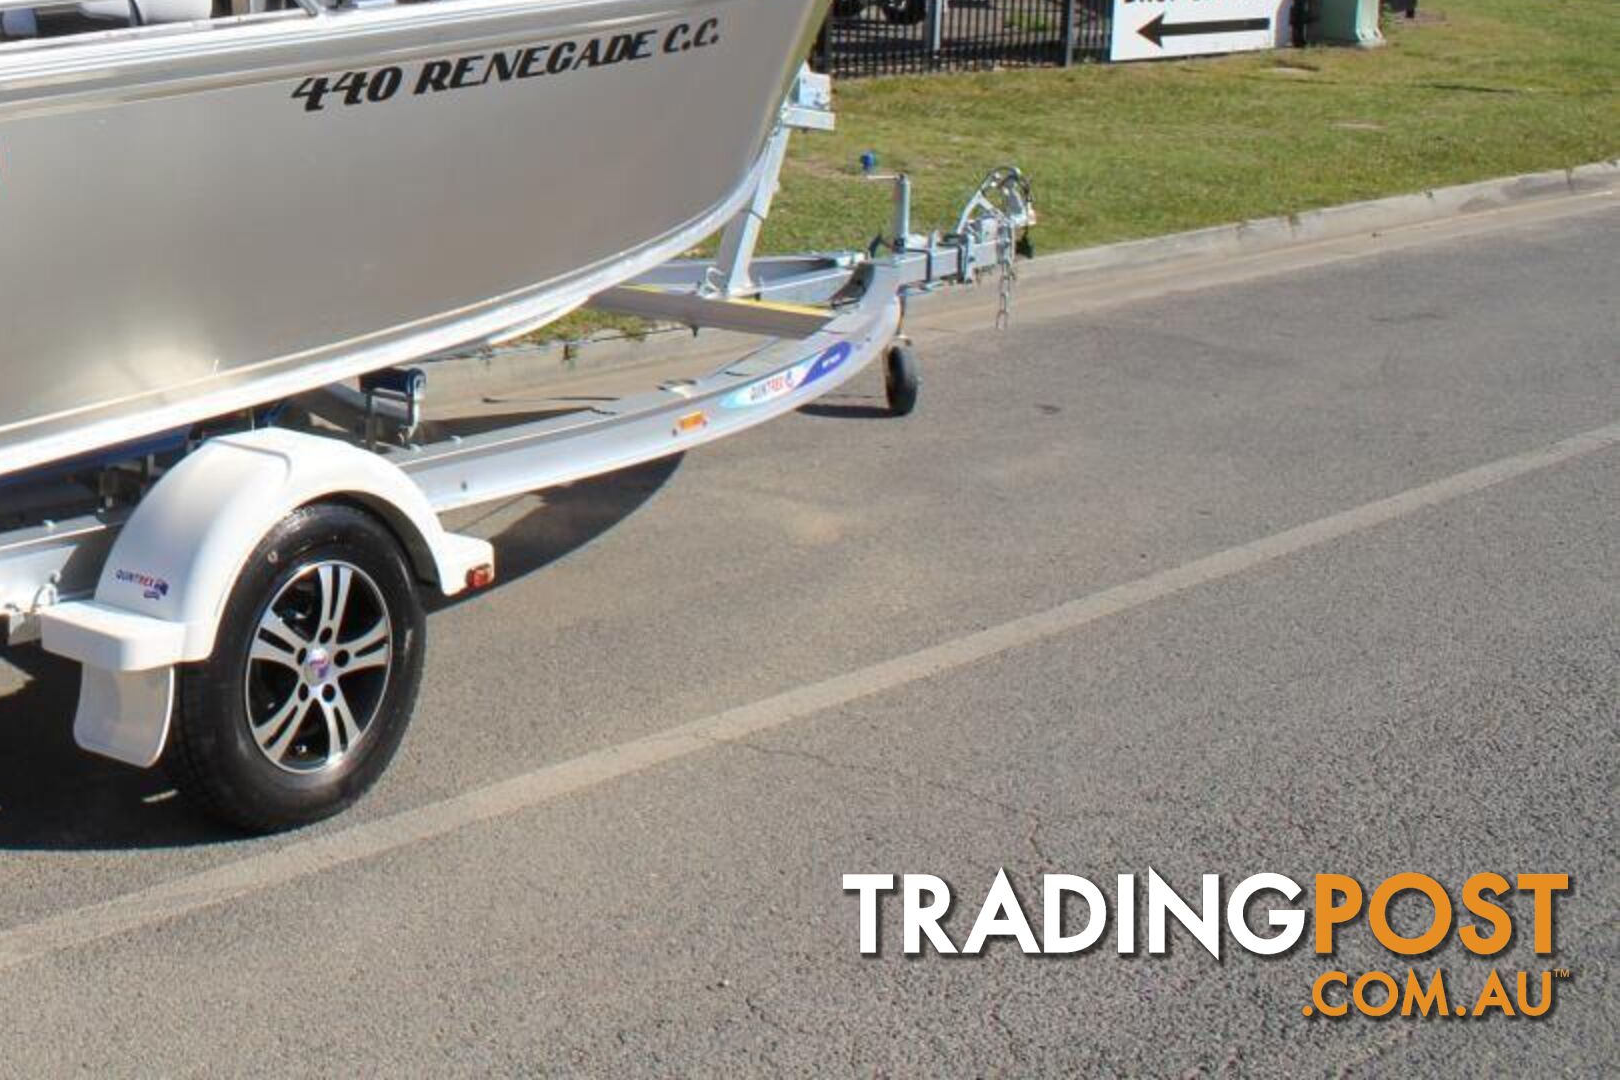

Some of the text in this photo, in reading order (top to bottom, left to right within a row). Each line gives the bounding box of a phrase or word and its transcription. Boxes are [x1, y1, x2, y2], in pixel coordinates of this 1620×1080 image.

[291, 18, 721, 112] 440 RENEGADE C.C.
